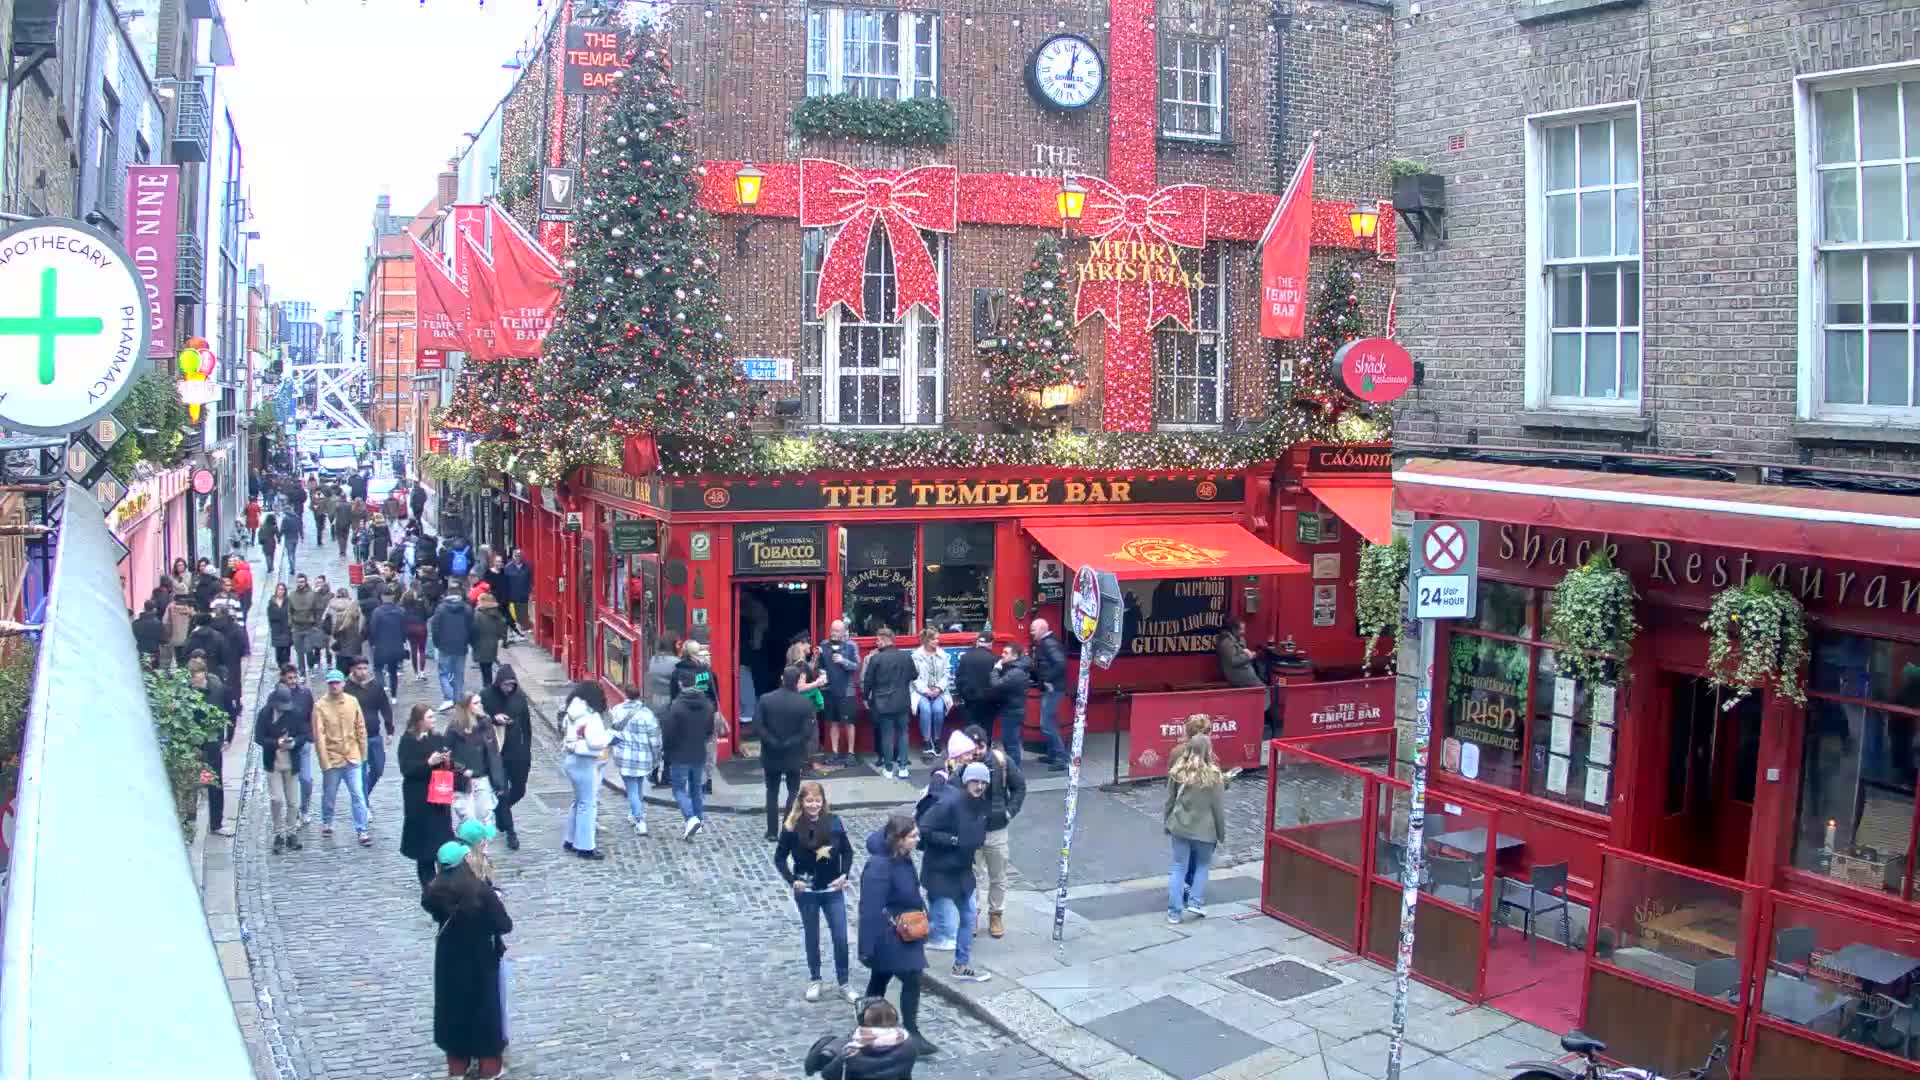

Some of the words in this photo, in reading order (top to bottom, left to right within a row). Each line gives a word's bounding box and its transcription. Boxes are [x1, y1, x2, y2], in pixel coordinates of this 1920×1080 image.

[584, 32, 617, 48] THE
[1032, 143, 1080, 165] THE
[136, 174, 169, 235] NINE
[0, 235, 113, 269] APOTHECARY
[1088, 240, 1184, 265] MERRY
[1070, 262, 1205, 290] HRISTMAS
[1278, 276, 1293, 288] THE
[519, 308, 545, 317] THE
[1272, 303, 1296, 316] BAR
[500, 317, 553, 330] TEMPL
[433, 329, 456, 338] BAR
[516, 329, 547, 341] BAR
[88, 305, 136, 405] PHARMACY
[708, 492, 725, 503] 48
[823, 485, 897, 507] THE
[912, 482, 1049, 505] TEMPLE
[1065, 481, 1132, 503] BAR
[1500, 525, 1620, 570] Shack
[873, 558, 888, 566] THE
[848, 569, 889, 592] TEMPLE
[891, 571, 913, 590] BAR
[1210, 597, 1225, 611] OF
[1420, 587, 1442, 607] 24
[1443, 597, 1465, 606] HOUR
[1137, 620, 1180, 636] MALTED
[1311, 710, 1355, 724] TEMPLE
[1358, 707, 1381, 720] BAR
[1338, 703, 1355, 712] THE
[1160, 723, 1186, 736] TEM
[1212, 720, 1237, 733] BAR
